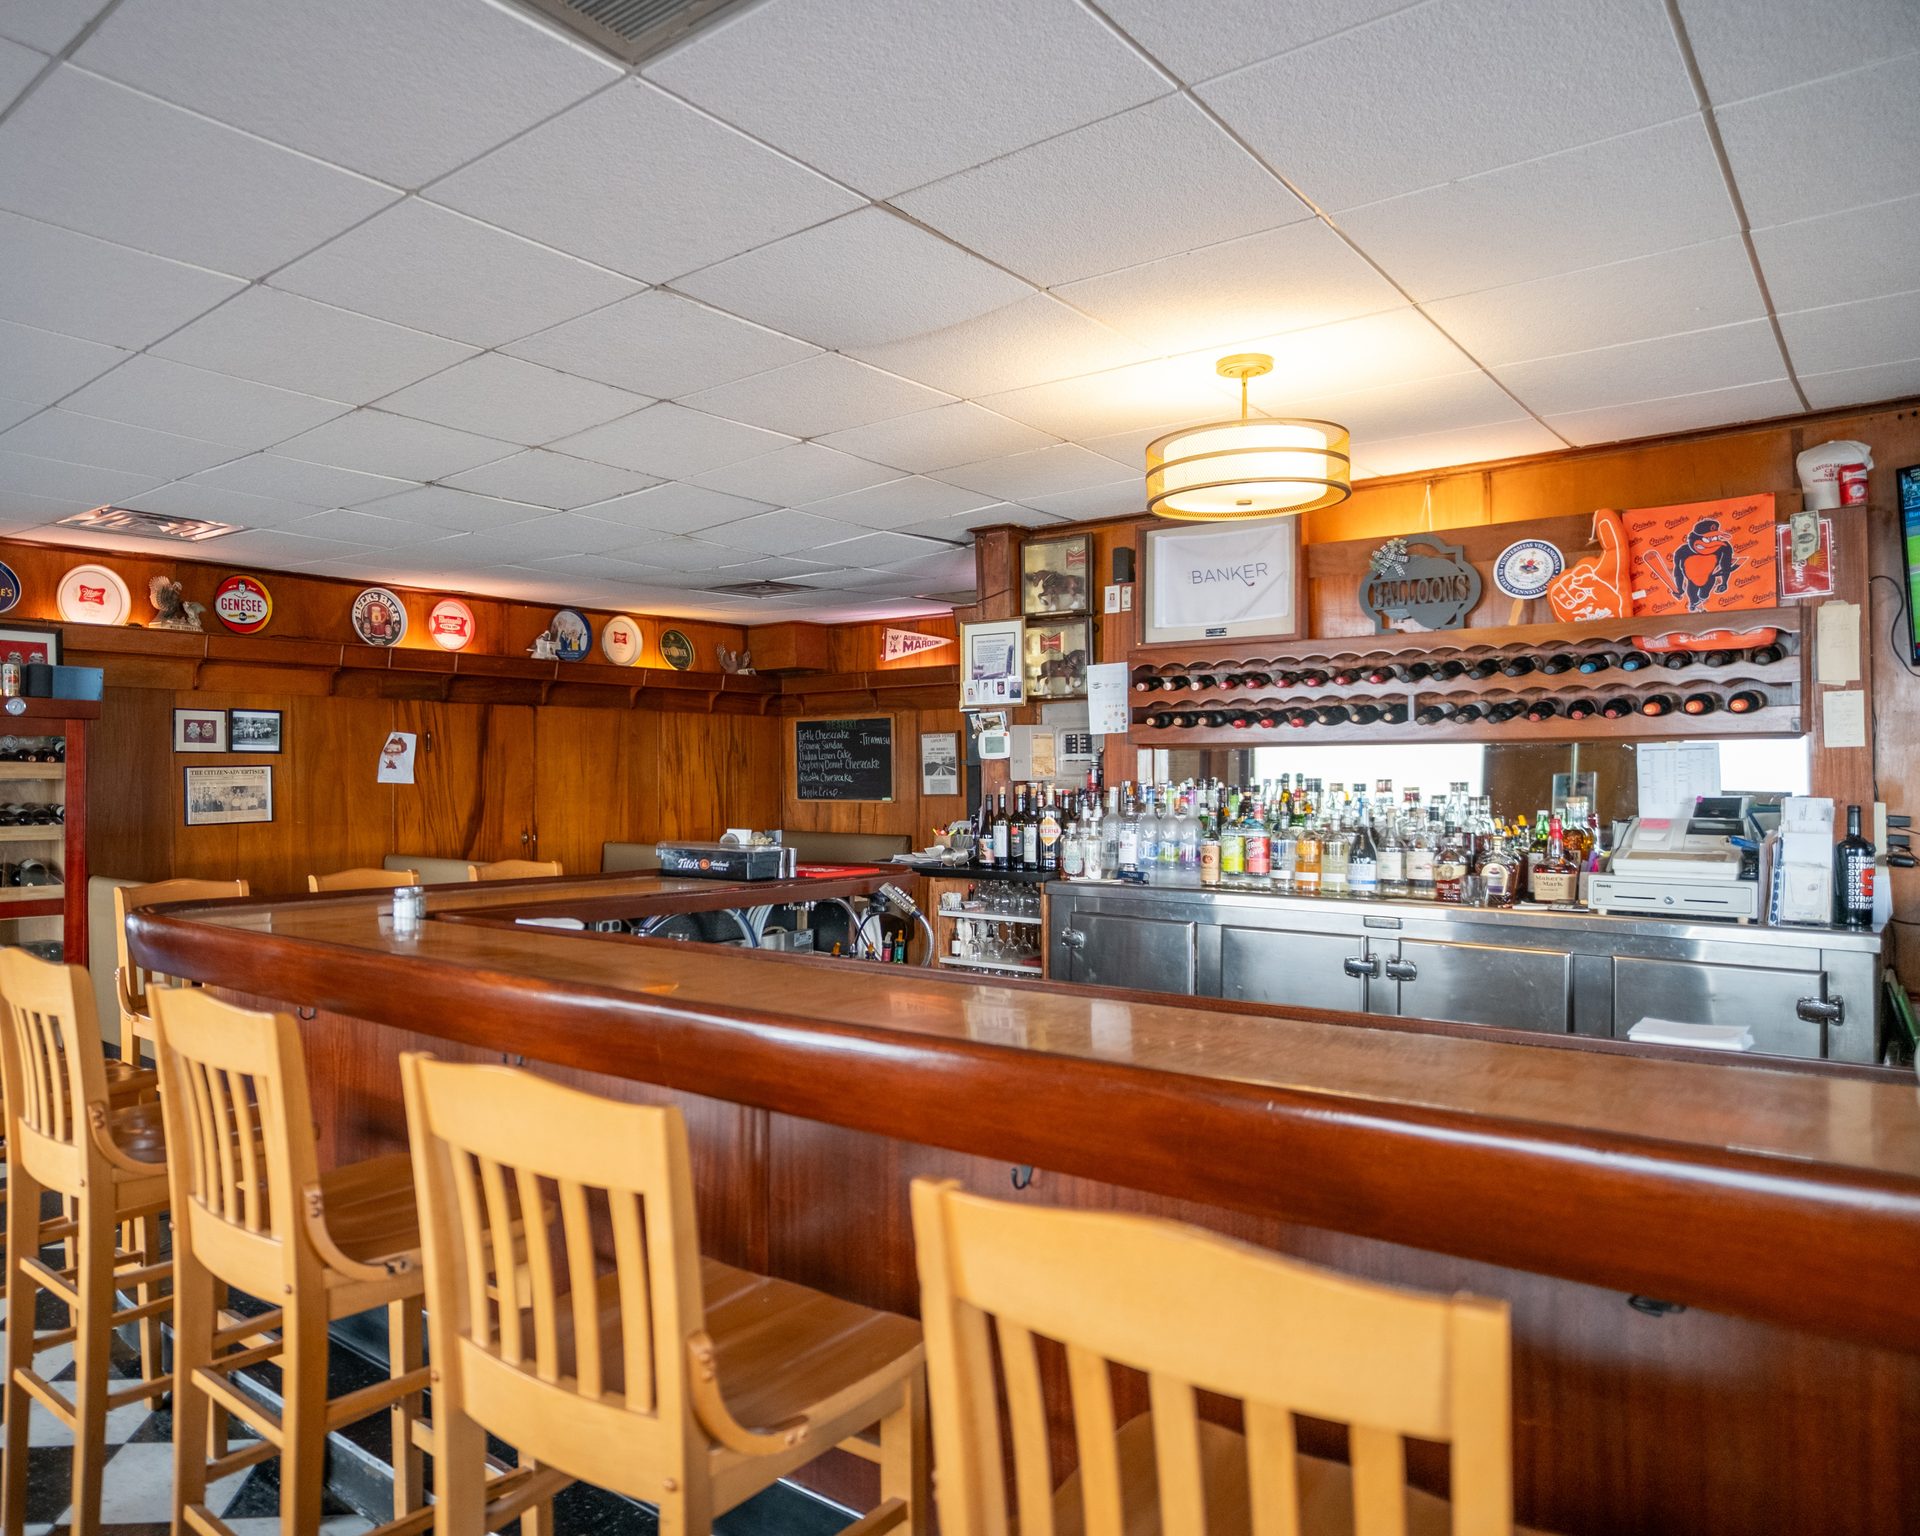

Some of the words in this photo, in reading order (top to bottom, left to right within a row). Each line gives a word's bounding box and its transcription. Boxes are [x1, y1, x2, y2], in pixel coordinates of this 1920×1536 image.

[1664, 514, 1690, 529] Orioles
[1731, 504, 1758, 520] Orioles
[1500, 542, 1534, 565] UNIVERSITAS
[1191, 562, 1268, 587] BANKER
[1734, 573, 1761, 588] Orioles
[1374, 574, 1470, 608] BALLOONS
[220, 597, 263, 613] GENESEE
[379, 594, 400, 622] BIER
[1651, 601, 1677, 613] Orioles
[1718, 594, 1745, 607] Orioles
[677, 857, 699, 870] Tito's
[1535, 874, 1564, 882] Maker's
